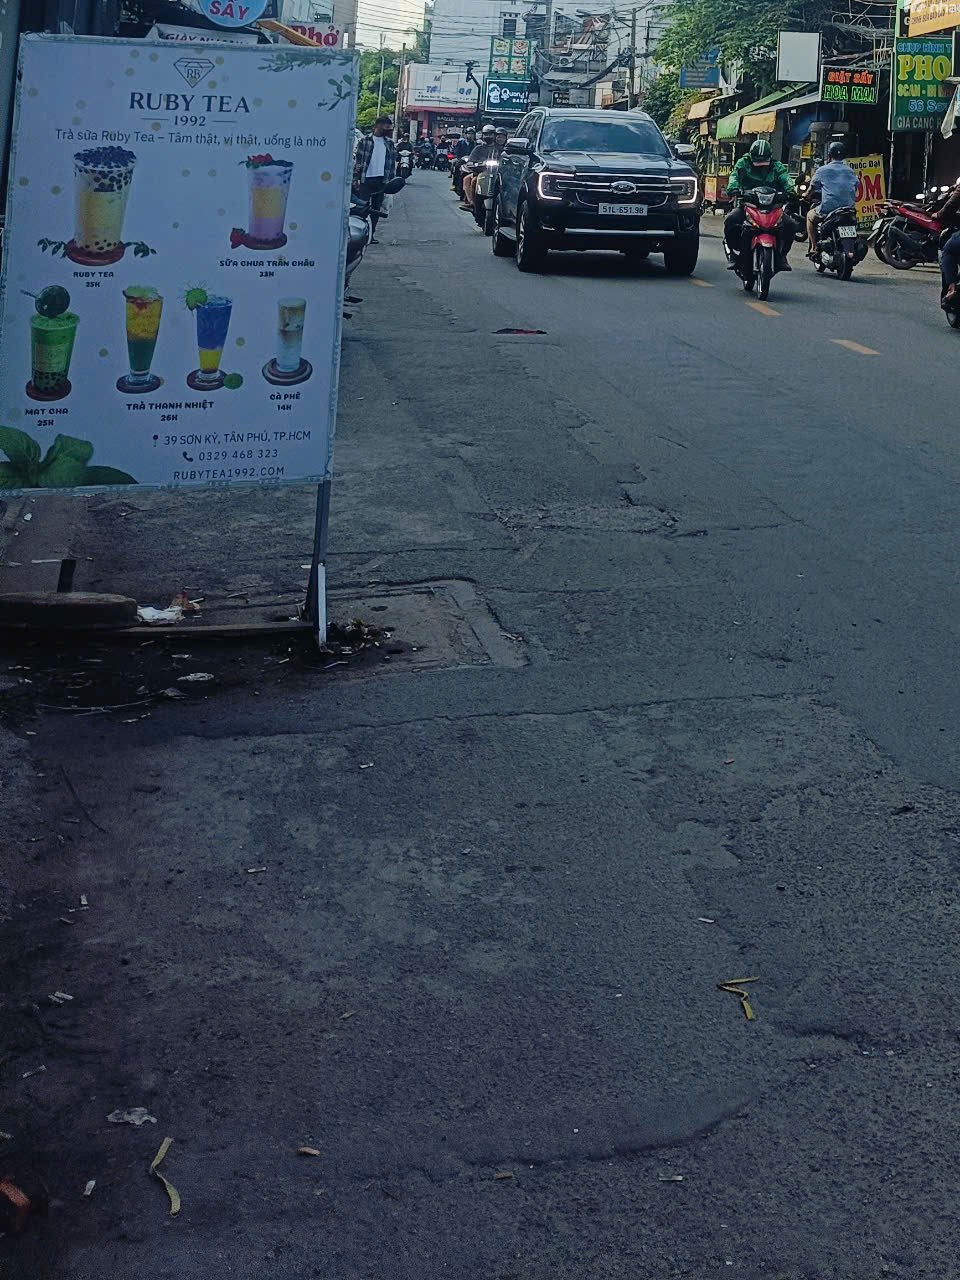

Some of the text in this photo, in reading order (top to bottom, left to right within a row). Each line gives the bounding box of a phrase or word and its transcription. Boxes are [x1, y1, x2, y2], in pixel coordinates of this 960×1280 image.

[897, 54, 953, 81] PHO
[828, 69, 873, 85] GIẶT SẤY
[824, 84, 875, 103] HOA MAI
[129, 91, 250, 114] RUBY TEA
[173, 115, 207, 128] 1992
[55, 128, 74, 141] Trà
[77, 129, 98, 142] sữa
[101, 130, 131, 145] Ruby
[133, 131, 155, 143] Tea
[168, 131, 193, 144] Tâm
[195, 131, 221, 146] thật,
[223, 133, 233, 147] vị
[236, 132, 261, 148] thật,
[264, 132, 292, 149] uống
[294, 134, 304, 147] là
[219, 258, 237, 267] SỮA
[240, 260, 266, 268] CHUA
[73, 271, 96, 279] RUBY
[270, 392, 301, 401] CÀ PHÊ
[49, 407, 69, 415] CHA
[126, 400, 215, 411] TRÀ THANH NHIỆT
[164, 430, 311, 446] 39 SƠN KỲ, TÂN PHÚ, TP.HCM
[198, 448, 279, 461] 0329 468 323
[173, 466, 285, 481] RUBYTEA1992.COM
